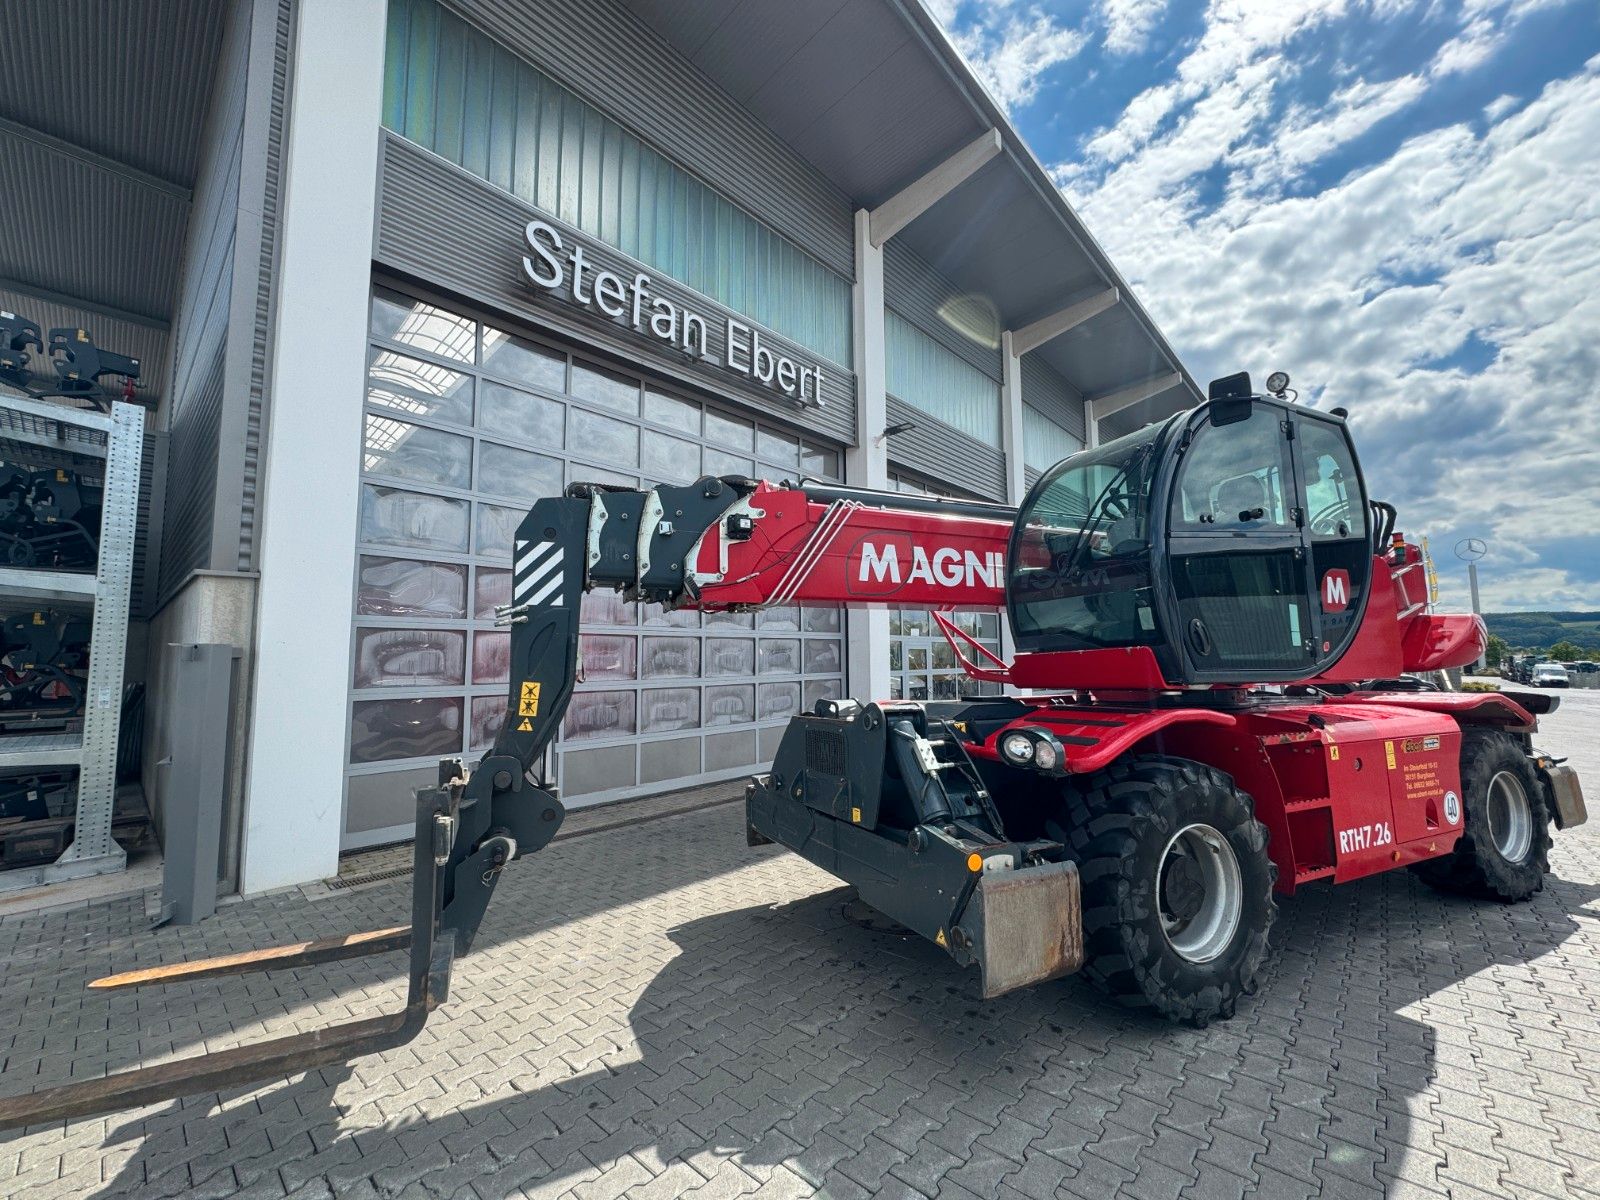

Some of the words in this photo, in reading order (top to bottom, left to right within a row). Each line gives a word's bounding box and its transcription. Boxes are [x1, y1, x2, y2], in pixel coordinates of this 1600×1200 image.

[522, 220, 706, 355] Stefan
[728, 318, 825, 406] Ebert
[859, 542, 1005, 588] MAGNI
[1326, 576, 1346, 604] M
[1339, 821, 1391, 854] RTH7.26
